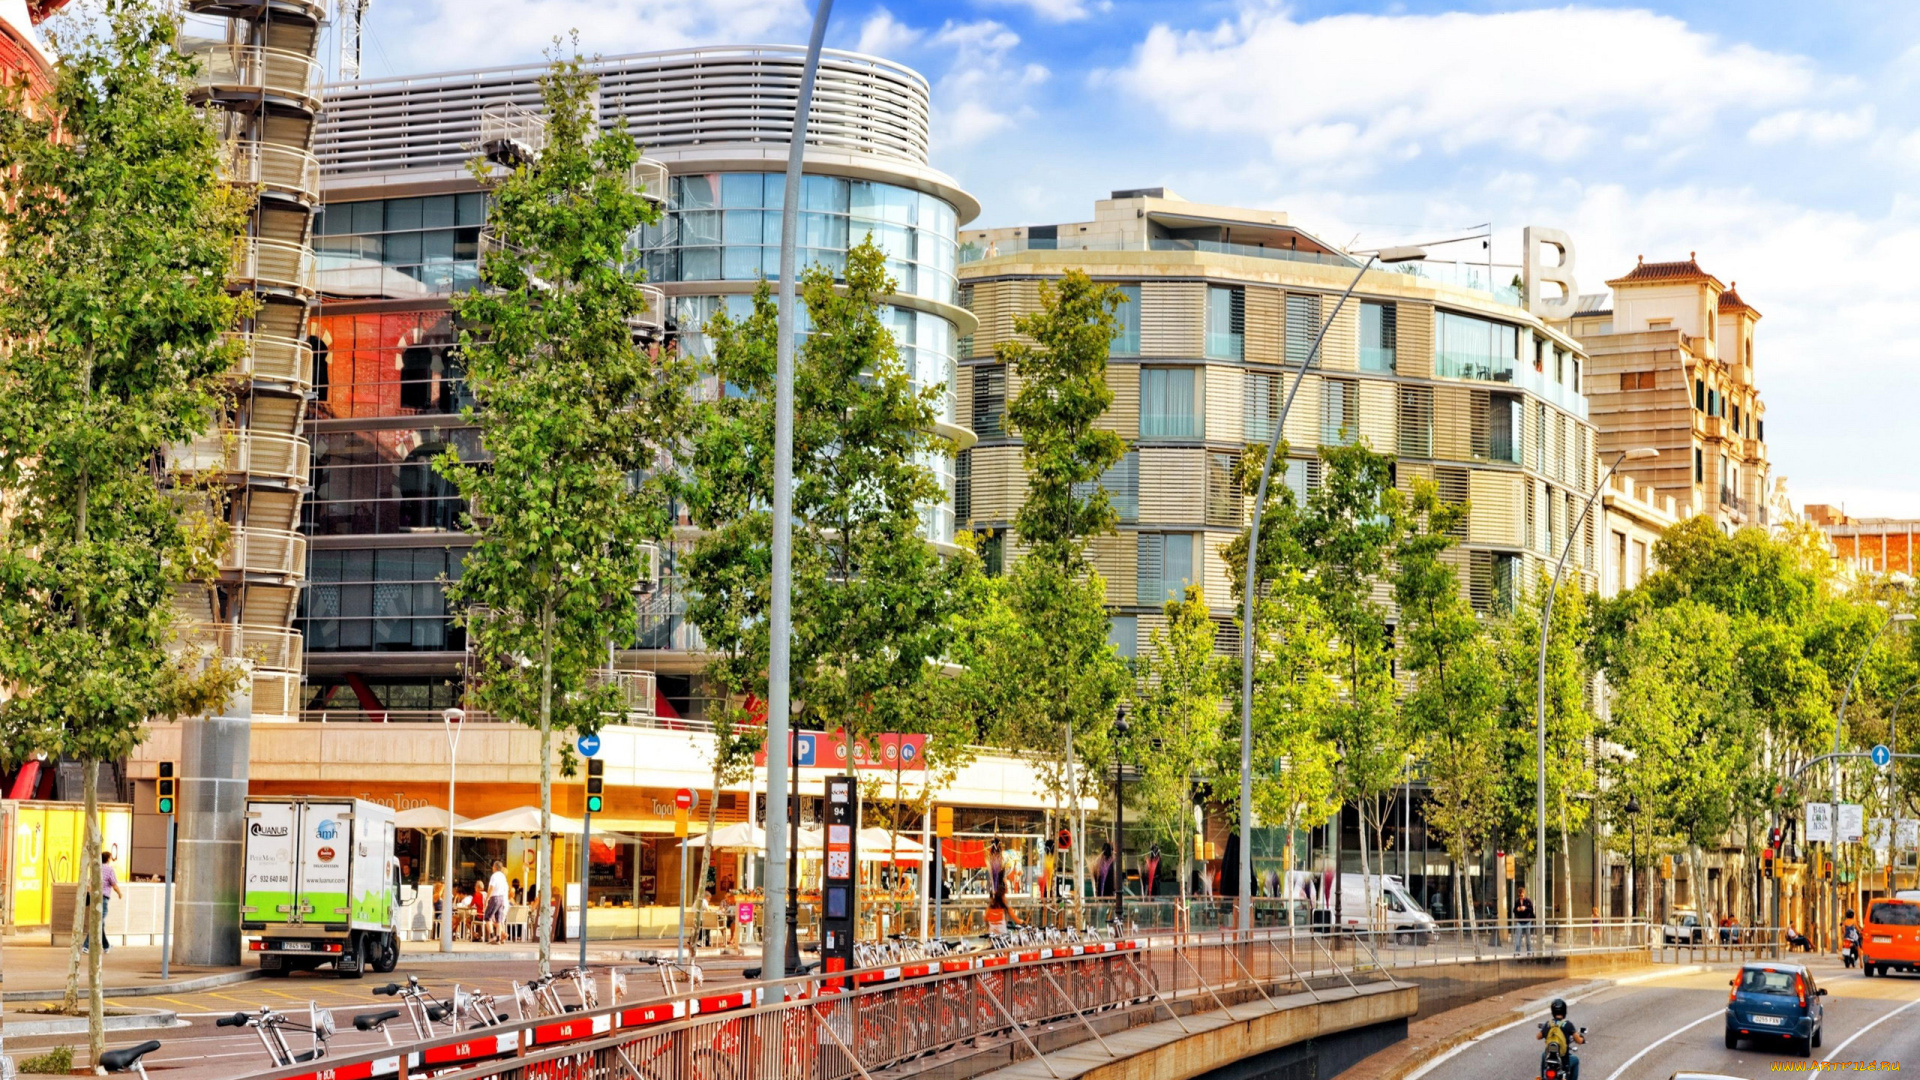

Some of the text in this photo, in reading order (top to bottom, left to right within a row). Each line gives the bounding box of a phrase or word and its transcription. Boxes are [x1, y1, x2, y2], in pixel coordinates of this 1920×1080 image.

[1523, 226, 1578, 319] B
[887, 748, 896, 756] 20
[833, 807, 845, 816] 94
[316, 829, 338, 839] amh
